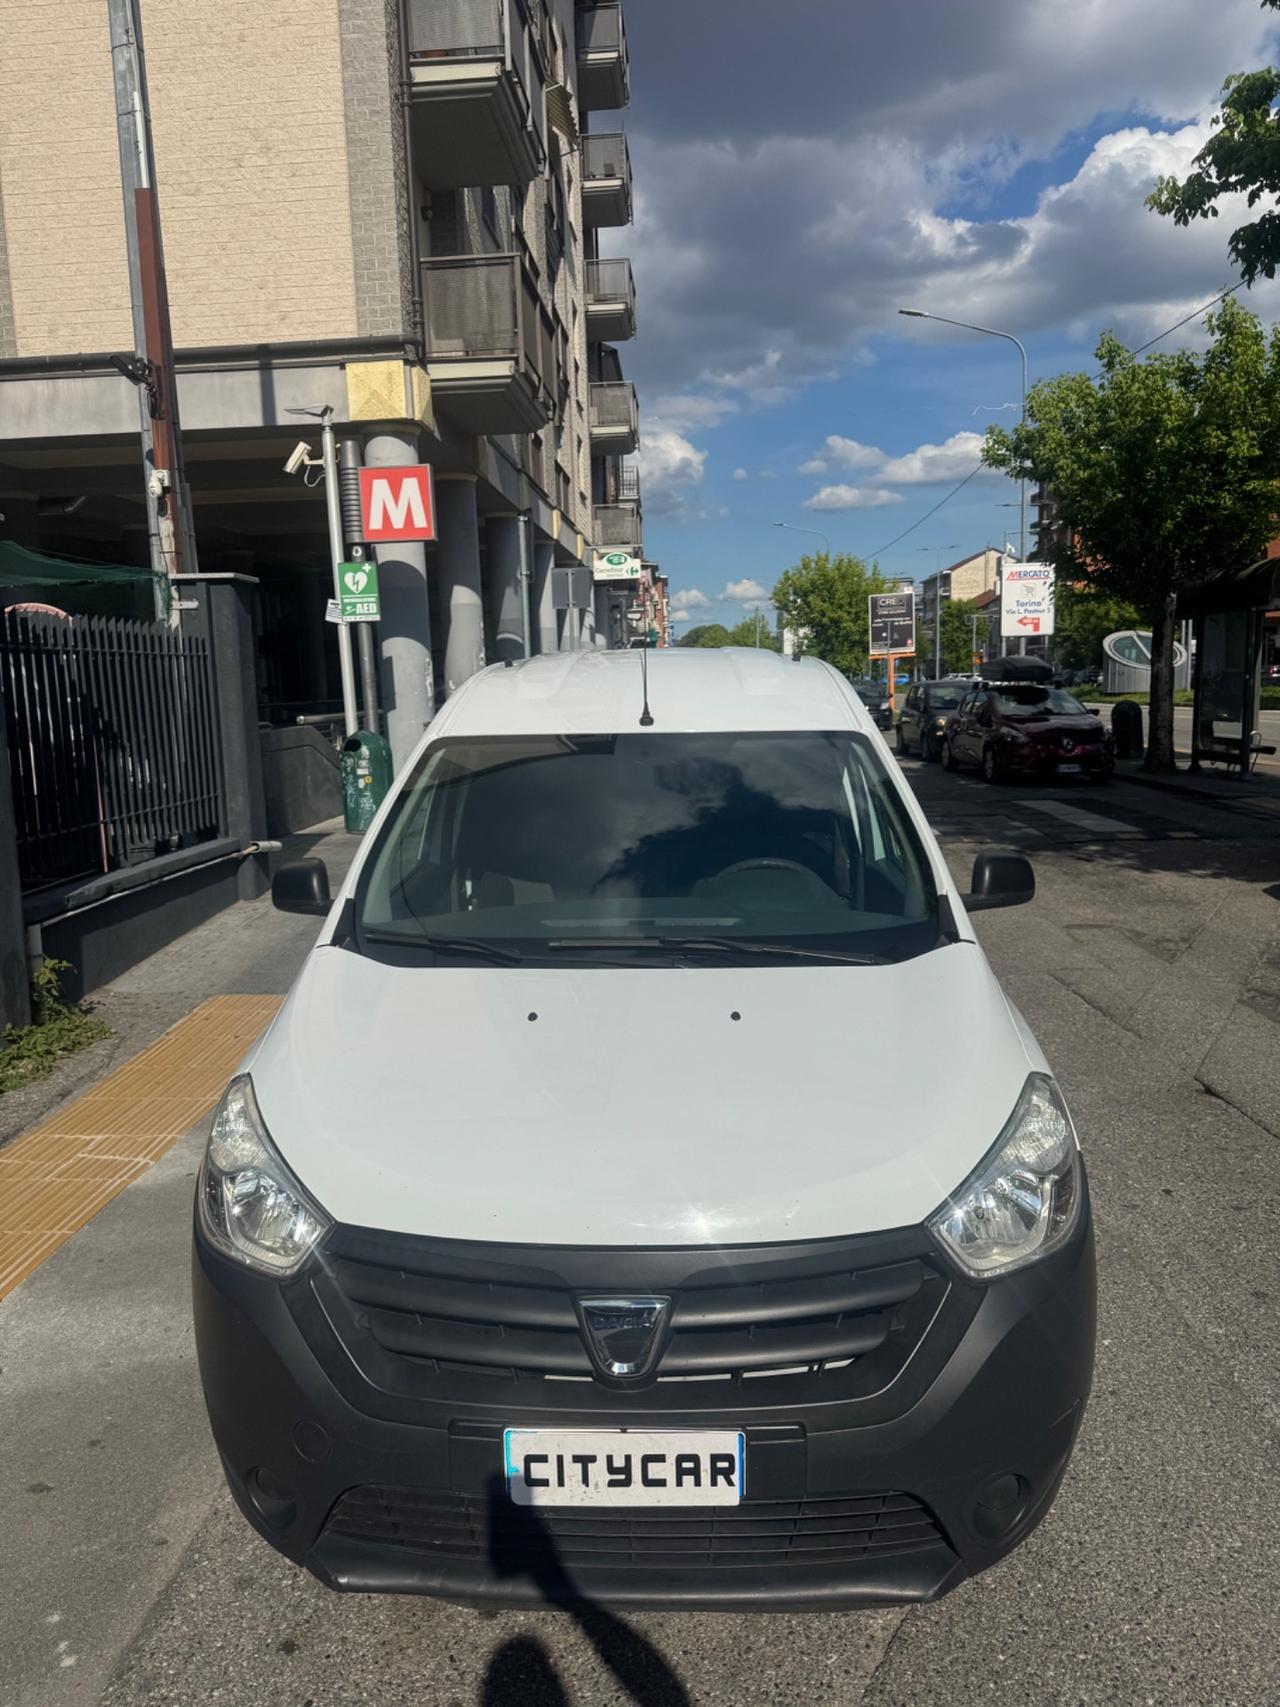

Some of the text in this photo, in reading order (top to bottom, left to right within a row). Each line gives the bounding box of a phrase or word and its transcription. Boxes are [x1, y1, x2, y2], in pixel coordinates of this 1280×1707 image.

[369, 477, 428, 530] M
[1007, 570, 1049, 580] MERCATO
[356, 603, 377, 614] AED
[1016, 600, 1042, 608] Torino
[524, 1453, 736, 1488] CITYCAR
